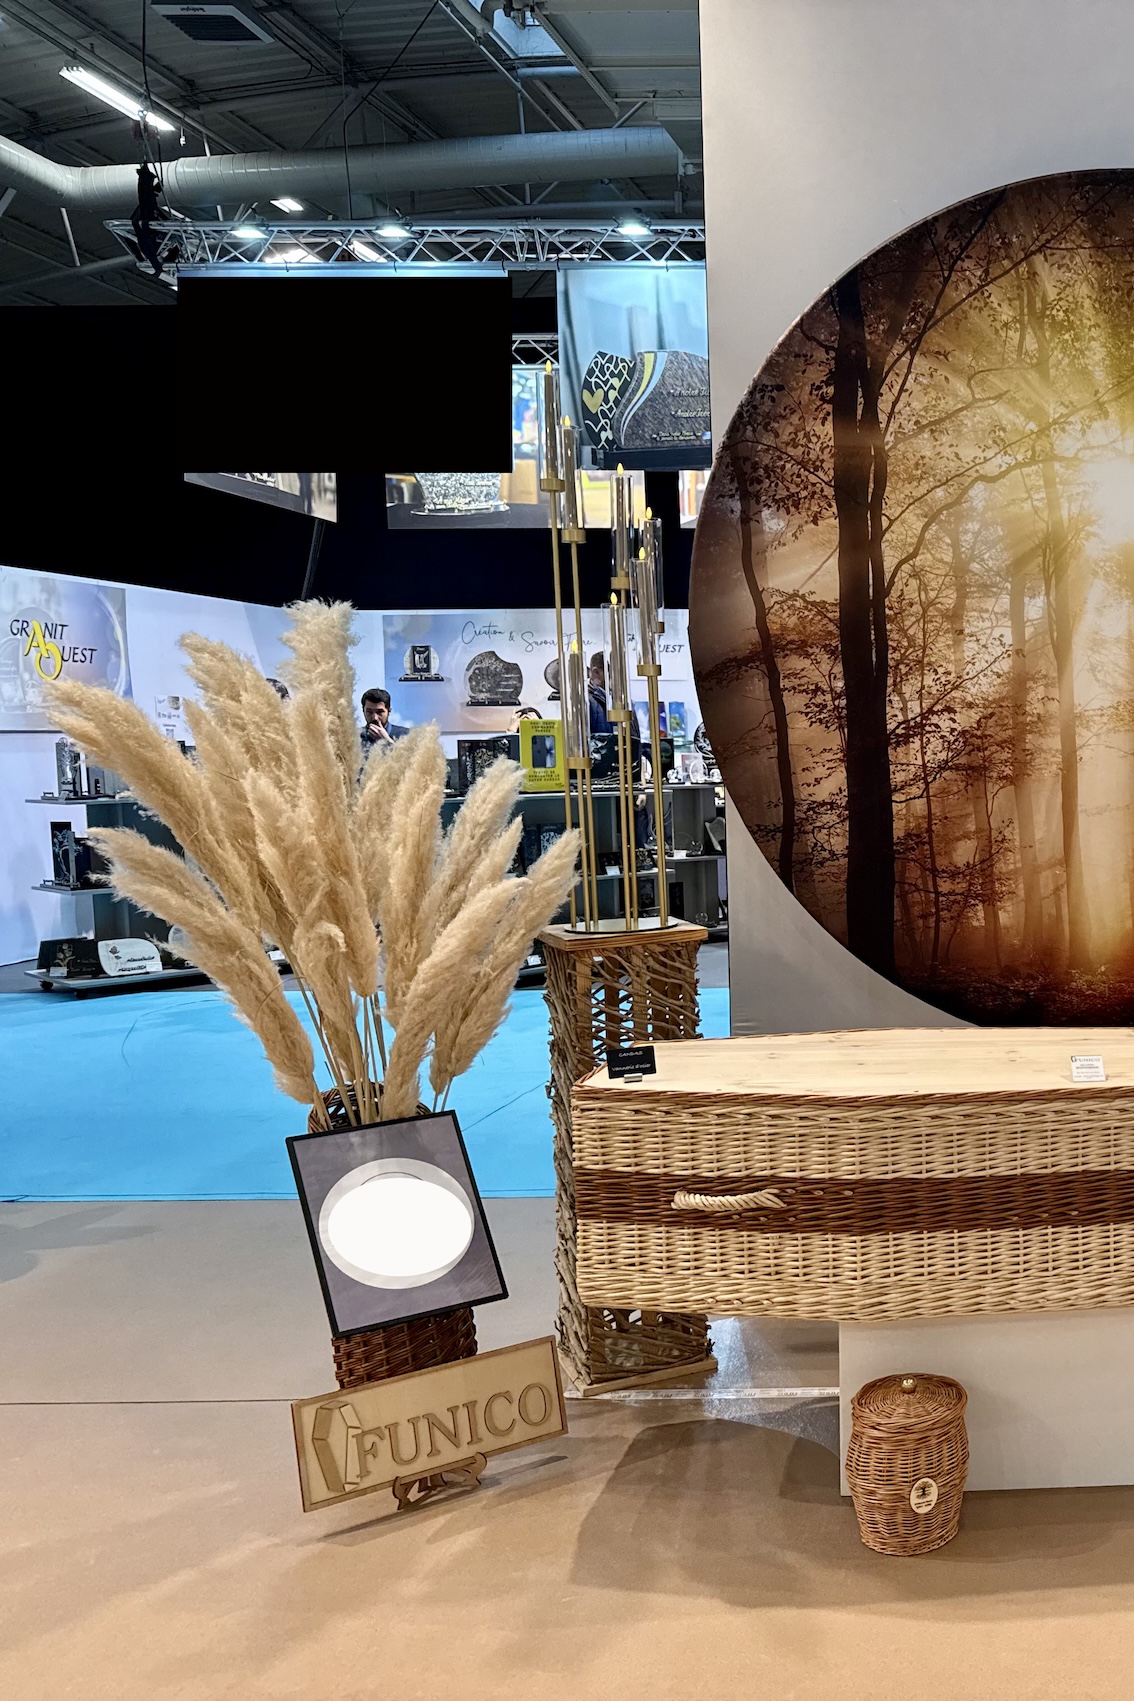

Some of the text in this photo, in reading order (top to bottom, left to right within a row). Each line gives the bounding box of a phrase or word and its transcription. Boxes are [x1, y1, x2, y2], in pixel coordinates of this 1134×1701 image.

[10, 619, 68, 658] GRANIT
[658, 643, 685, 654] UEST
[352, 1382, 553, 1478] FUNICO
